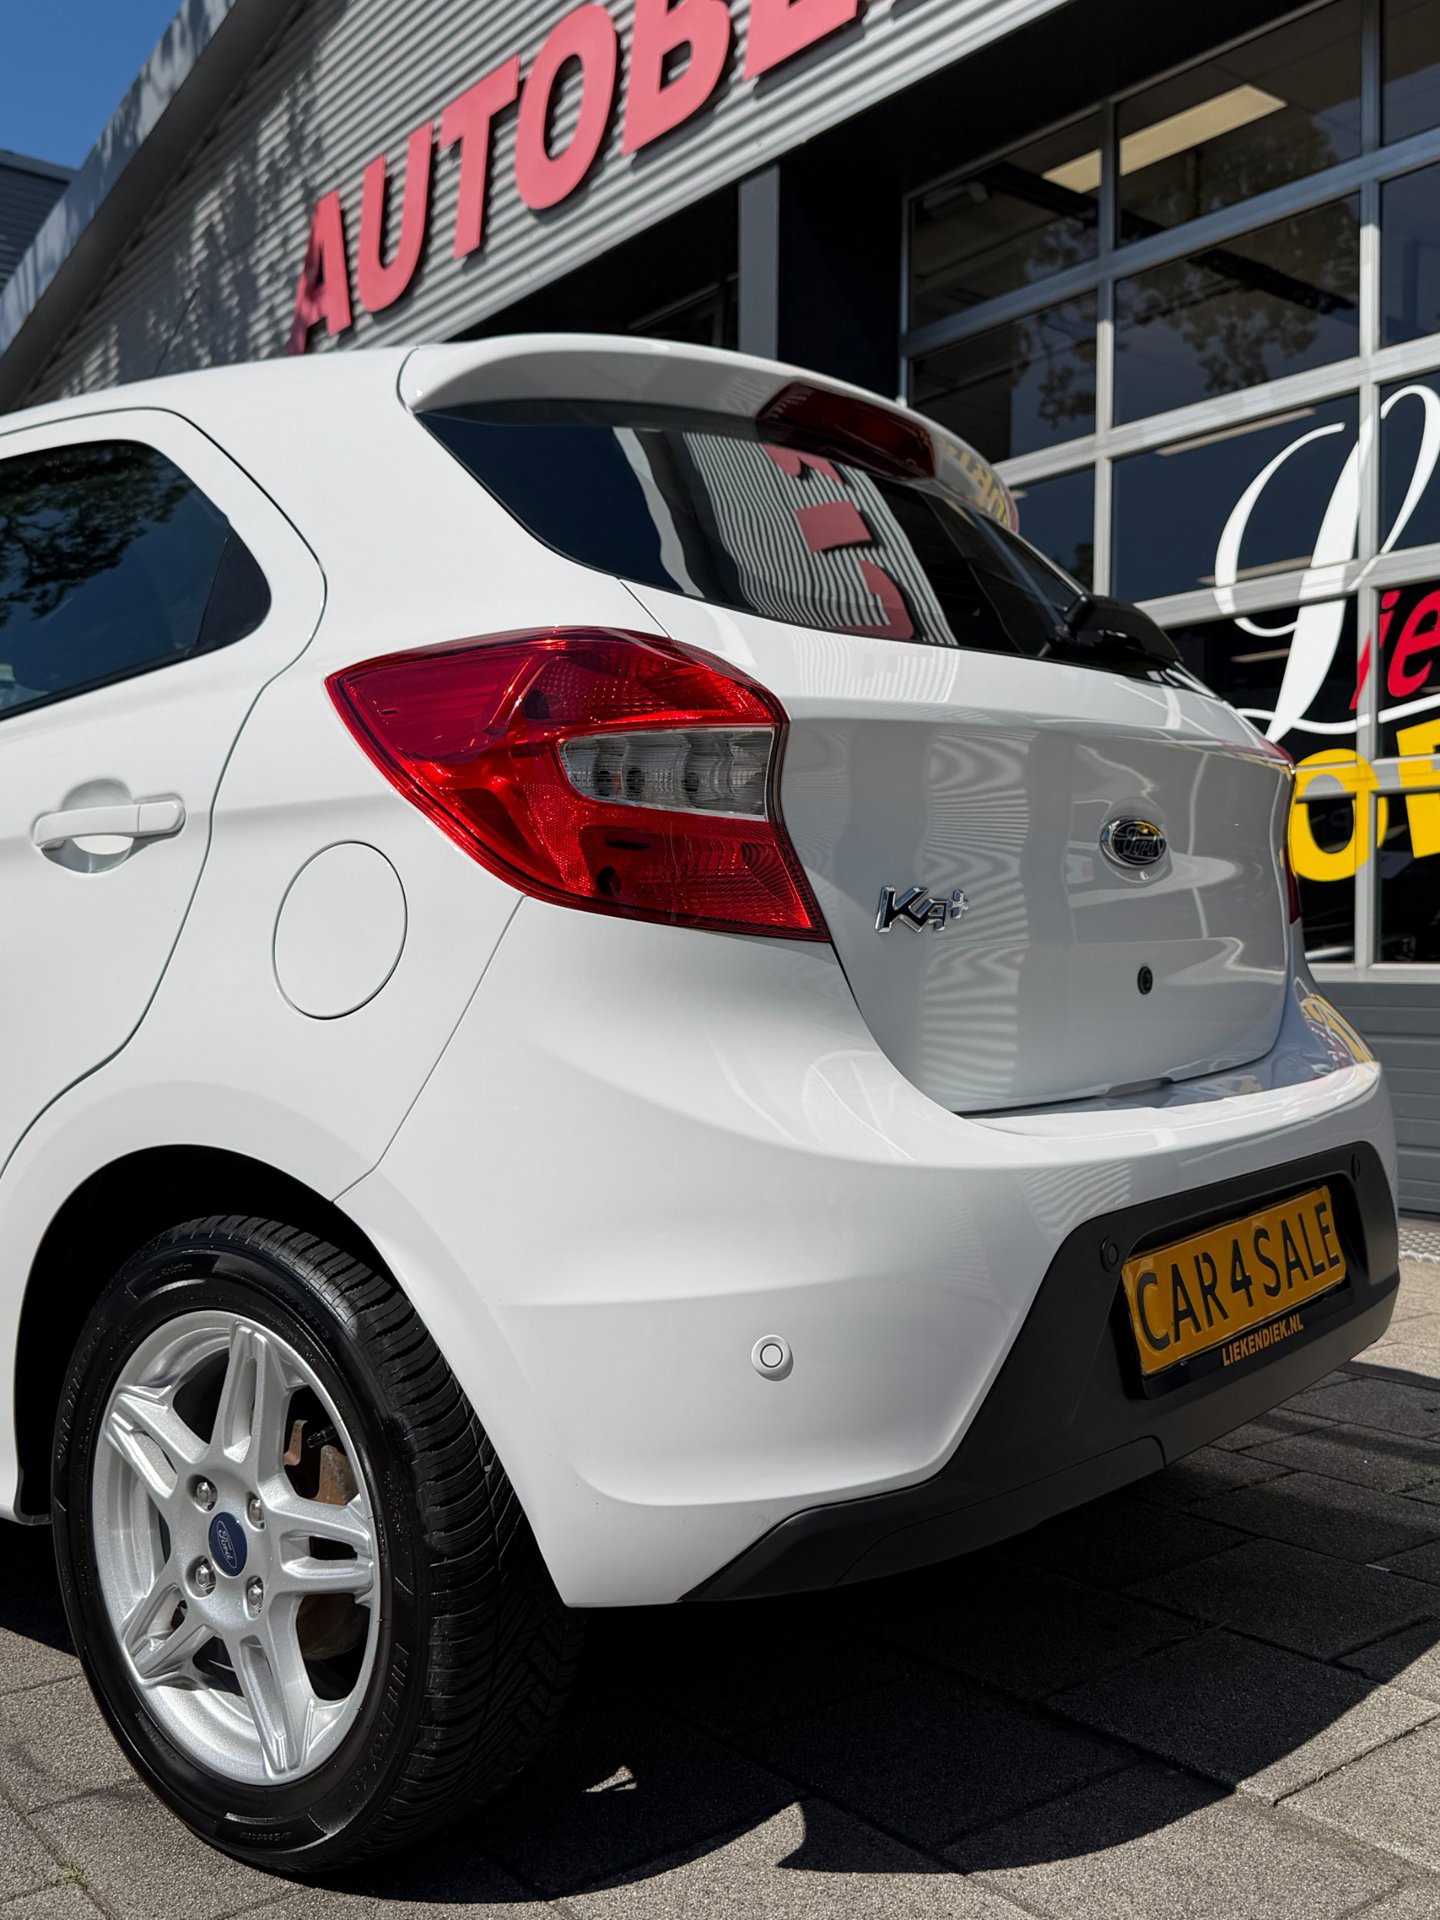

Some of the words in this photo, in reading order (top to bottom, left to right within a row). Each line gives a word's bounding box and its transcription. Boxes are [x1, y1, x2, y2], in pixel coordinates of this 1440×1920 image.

[1136, 1251, 1229, 1351] CAR
[1230, 1238, 1253, 1308] 4
[1253, 1201, 1341, 1298] SALE
[1222, 1313, 1304, 1367] LIEKENDIEK.NL
